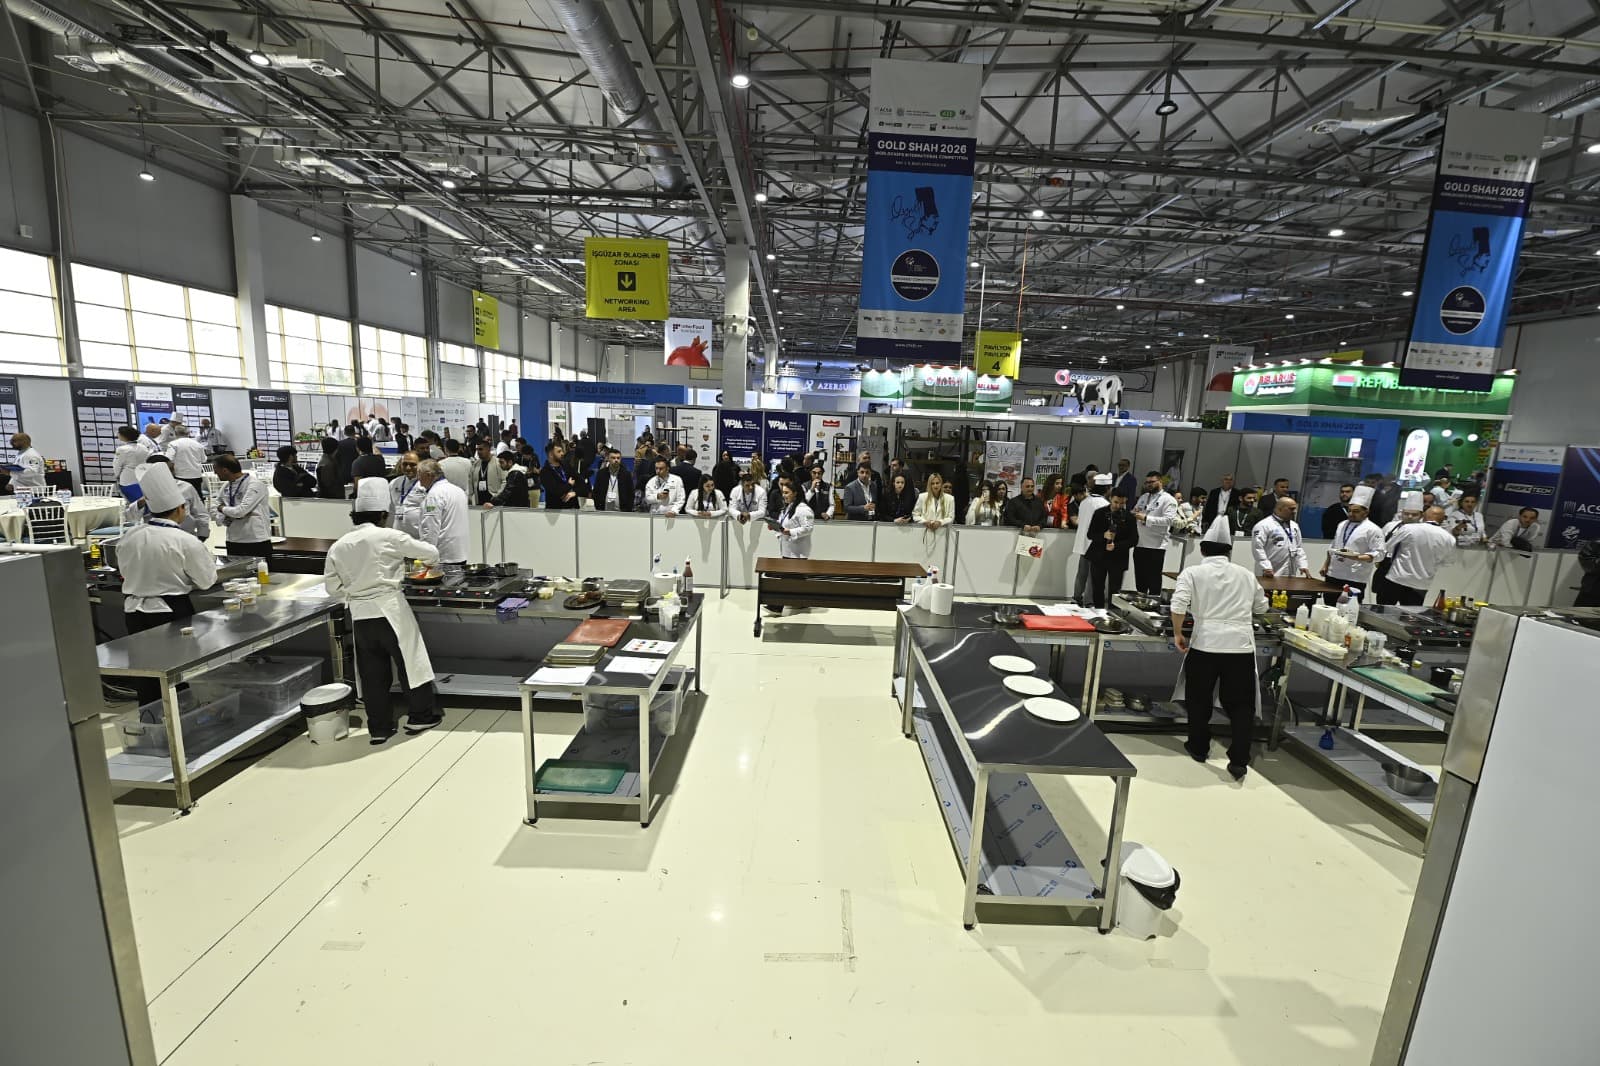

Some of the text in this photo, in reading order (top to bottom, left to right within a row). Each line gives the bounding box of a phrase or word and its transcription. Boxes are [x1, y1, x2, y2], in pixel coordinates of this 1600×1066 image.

[877, 140, 967, 154] GOLD SHAH 2026
[1443, 182, 1525, 197] GOLD SHAH 2026
[604, 298, 650, 306] NETWORKING
[991, 360, 1001, 371] 4
